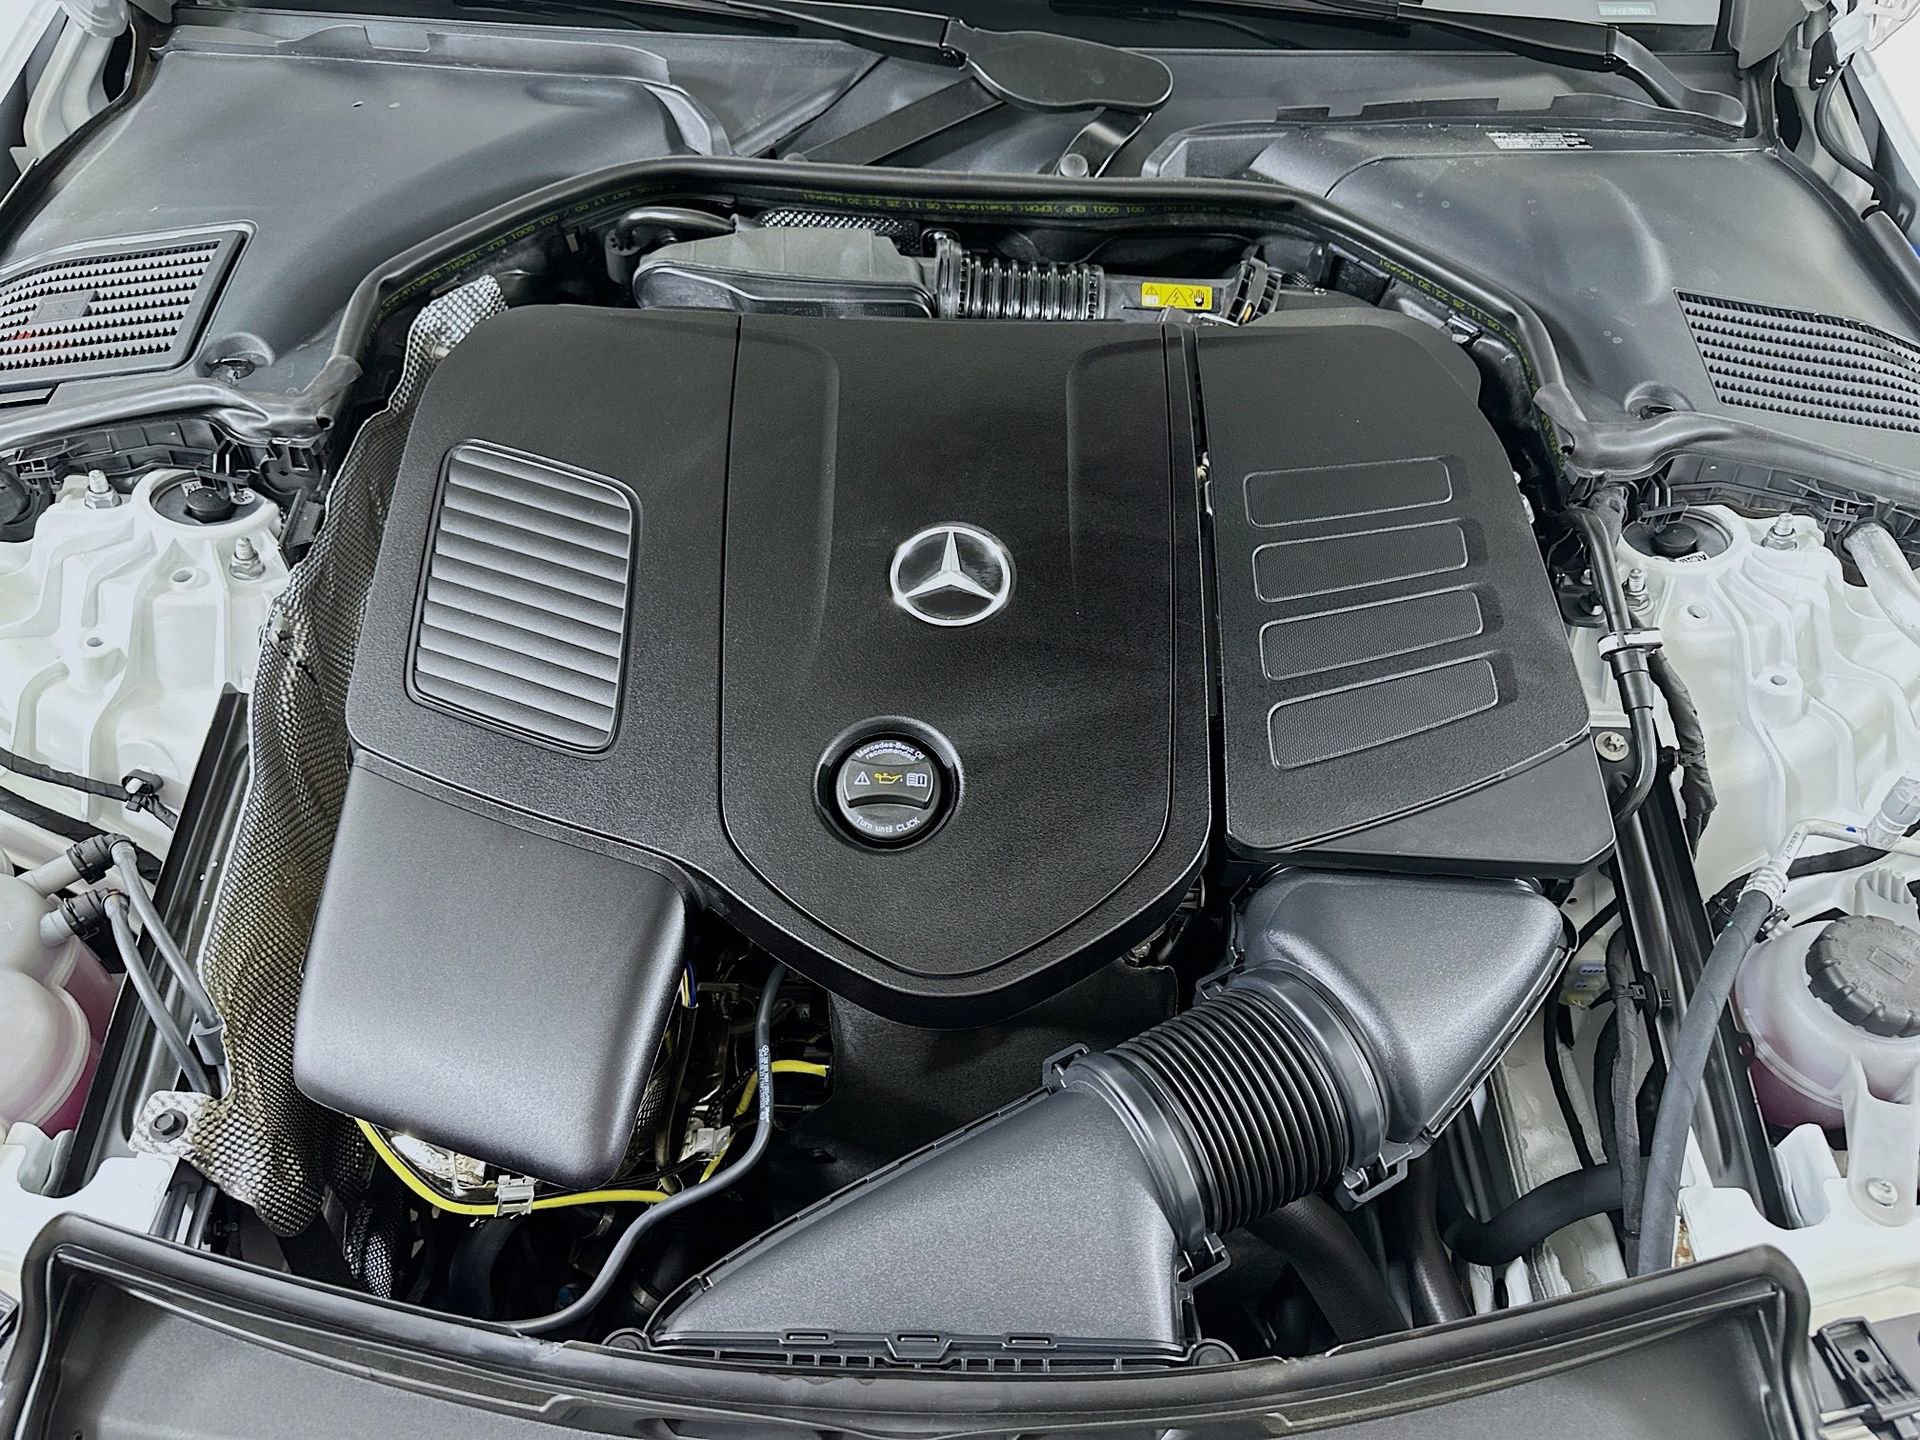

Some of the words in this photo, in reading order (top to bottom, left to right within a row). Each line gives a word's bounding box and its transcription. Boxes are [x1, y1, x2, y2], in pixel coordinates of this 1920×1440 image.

[1065, 204, 1089, 214] ELP
[855, 741, 915, 759] Mercedes-Benz
[865, 747, 918, 762] recommended
[856, 814, 873, 831] Turn
[875, 824, 893, 833] until
[896, 816, 921, 832] CLICK
